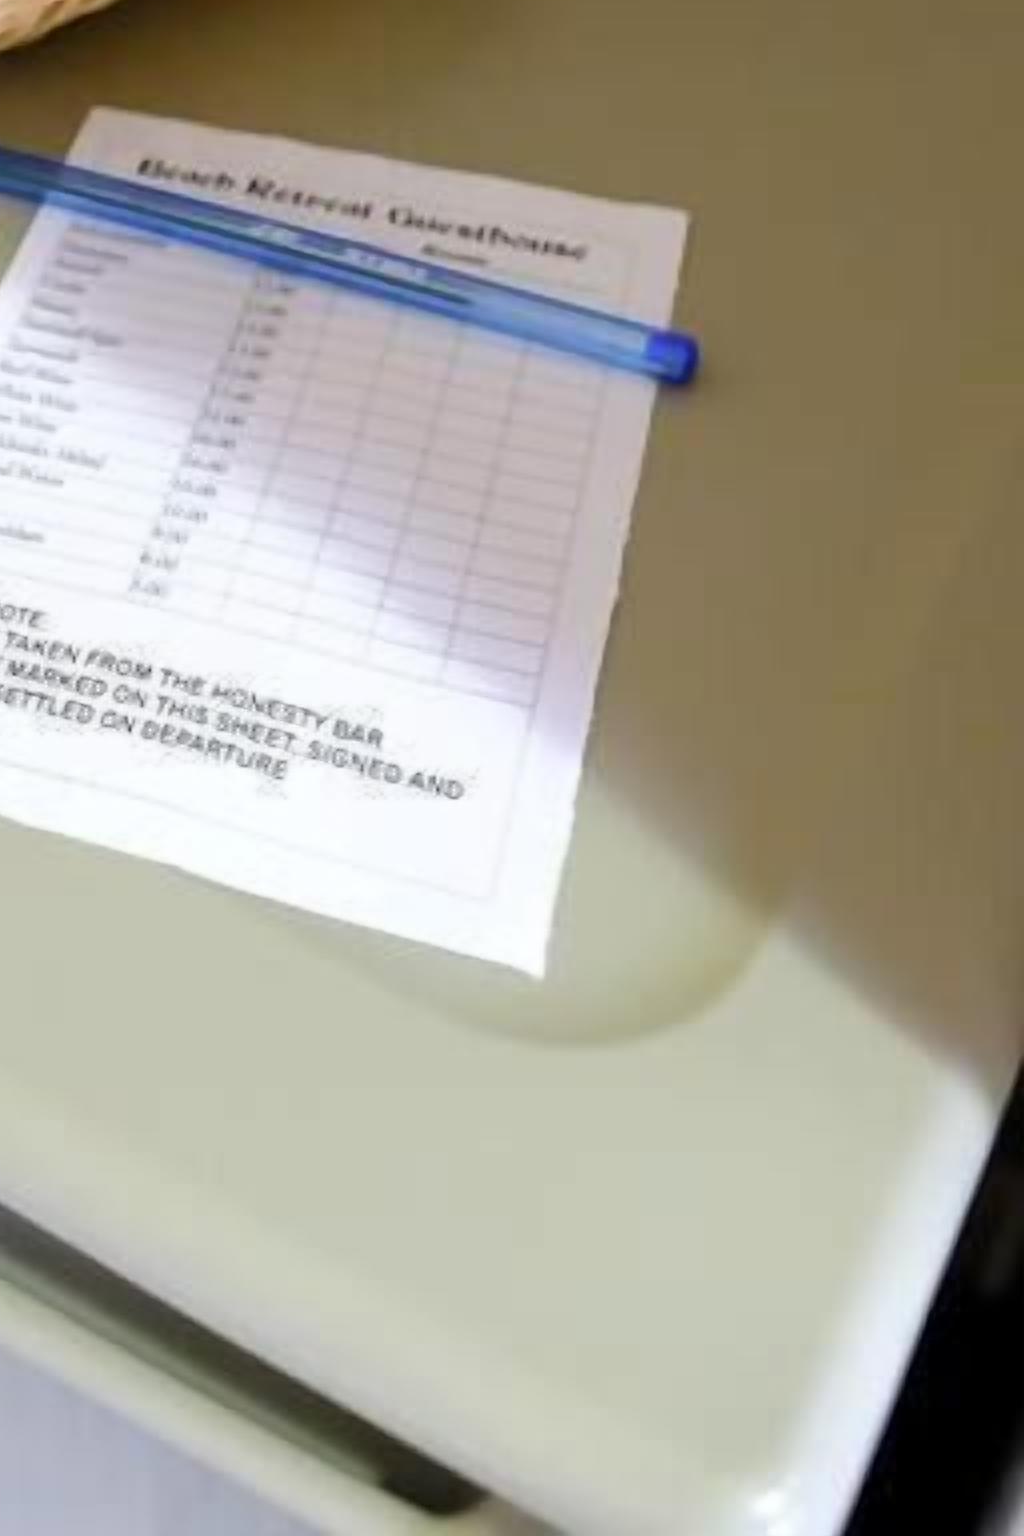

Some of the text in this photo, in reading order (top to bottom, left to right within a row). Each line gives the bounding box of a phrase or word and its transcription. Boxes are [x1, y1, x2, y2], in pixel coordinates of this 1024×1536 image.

[5, 630, 78, 664] TAKEN
[84, 648, 152, 680] FROM
[160, 666, 207, 696] THE
[211, 683, 328, 731] HONESTY
[332, 718, 384, 749] BAR
[7, 658, 108, 698] MARKED
[112, 682, 146, 709] ON
[155, 693, 209, 725] THIS
[307, 739, 403, 785] SIGNED
[408, 771, 464, 800] AND
[100, 709, 136, 734] ON
[140, 718, 288, 781] DEPARTURE
